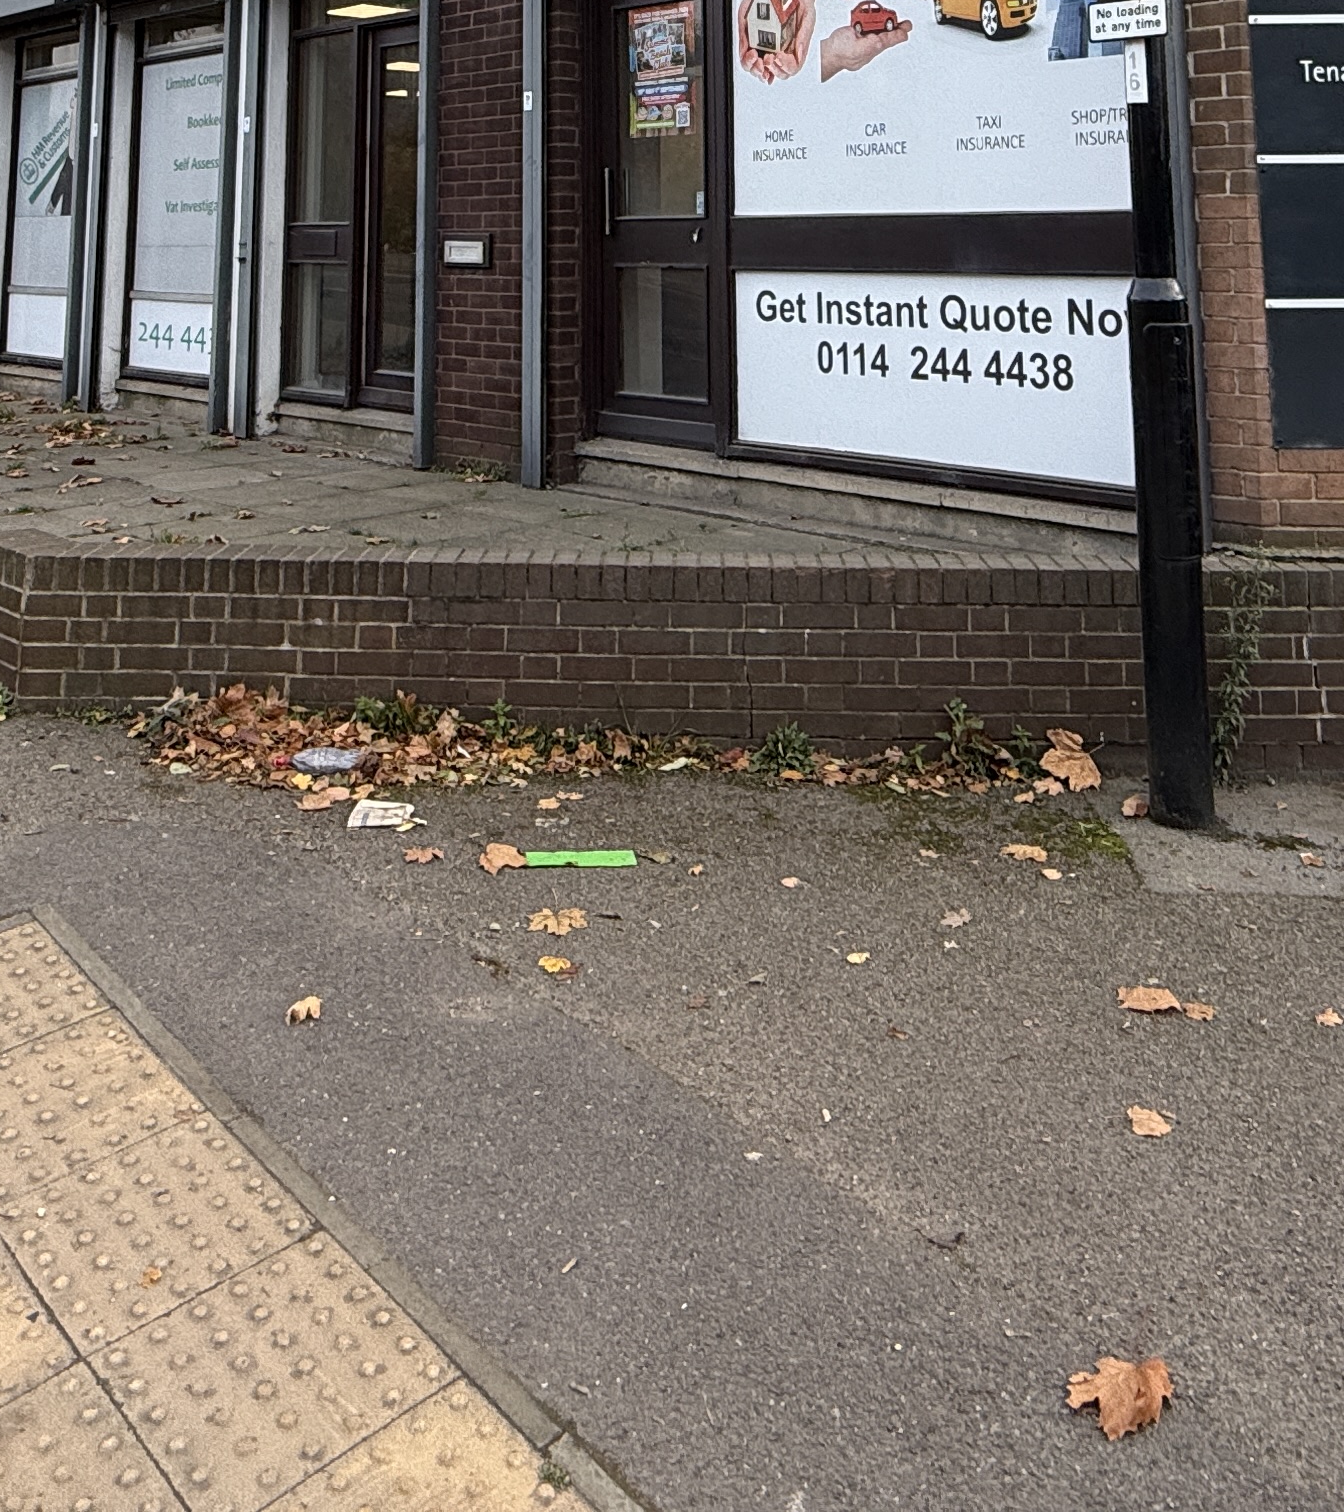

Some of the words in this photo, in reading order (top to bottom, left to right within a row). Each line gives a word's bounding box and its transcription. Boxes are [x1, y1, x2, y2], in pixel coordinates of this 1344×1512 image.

[1096, 8, 1112, 20] No
[1116, 4, 1159, 17] loading
[1095, 23, 1107, 34] at
[1111, 22, 1131, 33] any
[1136, 18, 1161, 29] time
[165, 74, 196, 91] Limited
[865, 123, 886, 137] CAR
[976, 115, 1002, 130] TAXI
[31, 138, 45, 159] HM
[42, 111, 70, 145] Revenue
[765, 129, 794, 142] HOME
[956, 134, 1026, 151] INSURANCE
[1075, 129, 1129, 147] INSURA
[37, 158, 46, 169] &
[42, 126, 71, 162] Customs
[752, 147, 808, 162] INSURANCE
[845, 141, 907, 157] INSURANCE
[173, 156, 188, 172] Self
[165, 201, 178, 213] Vat
[755, 290, 807, 324] Get
[817, 292, 929, 329] Instant
[940, 294, 1053, 335] Quote
[1067, 298, 1129, 337] No
[138, 321, 174, 350] 244
[180, 325, 212, 355] 44
[817, 341, 890, 377] 0114
[911, 345, 972, 383] 244
[984, 350, 1074, 391] 4438
